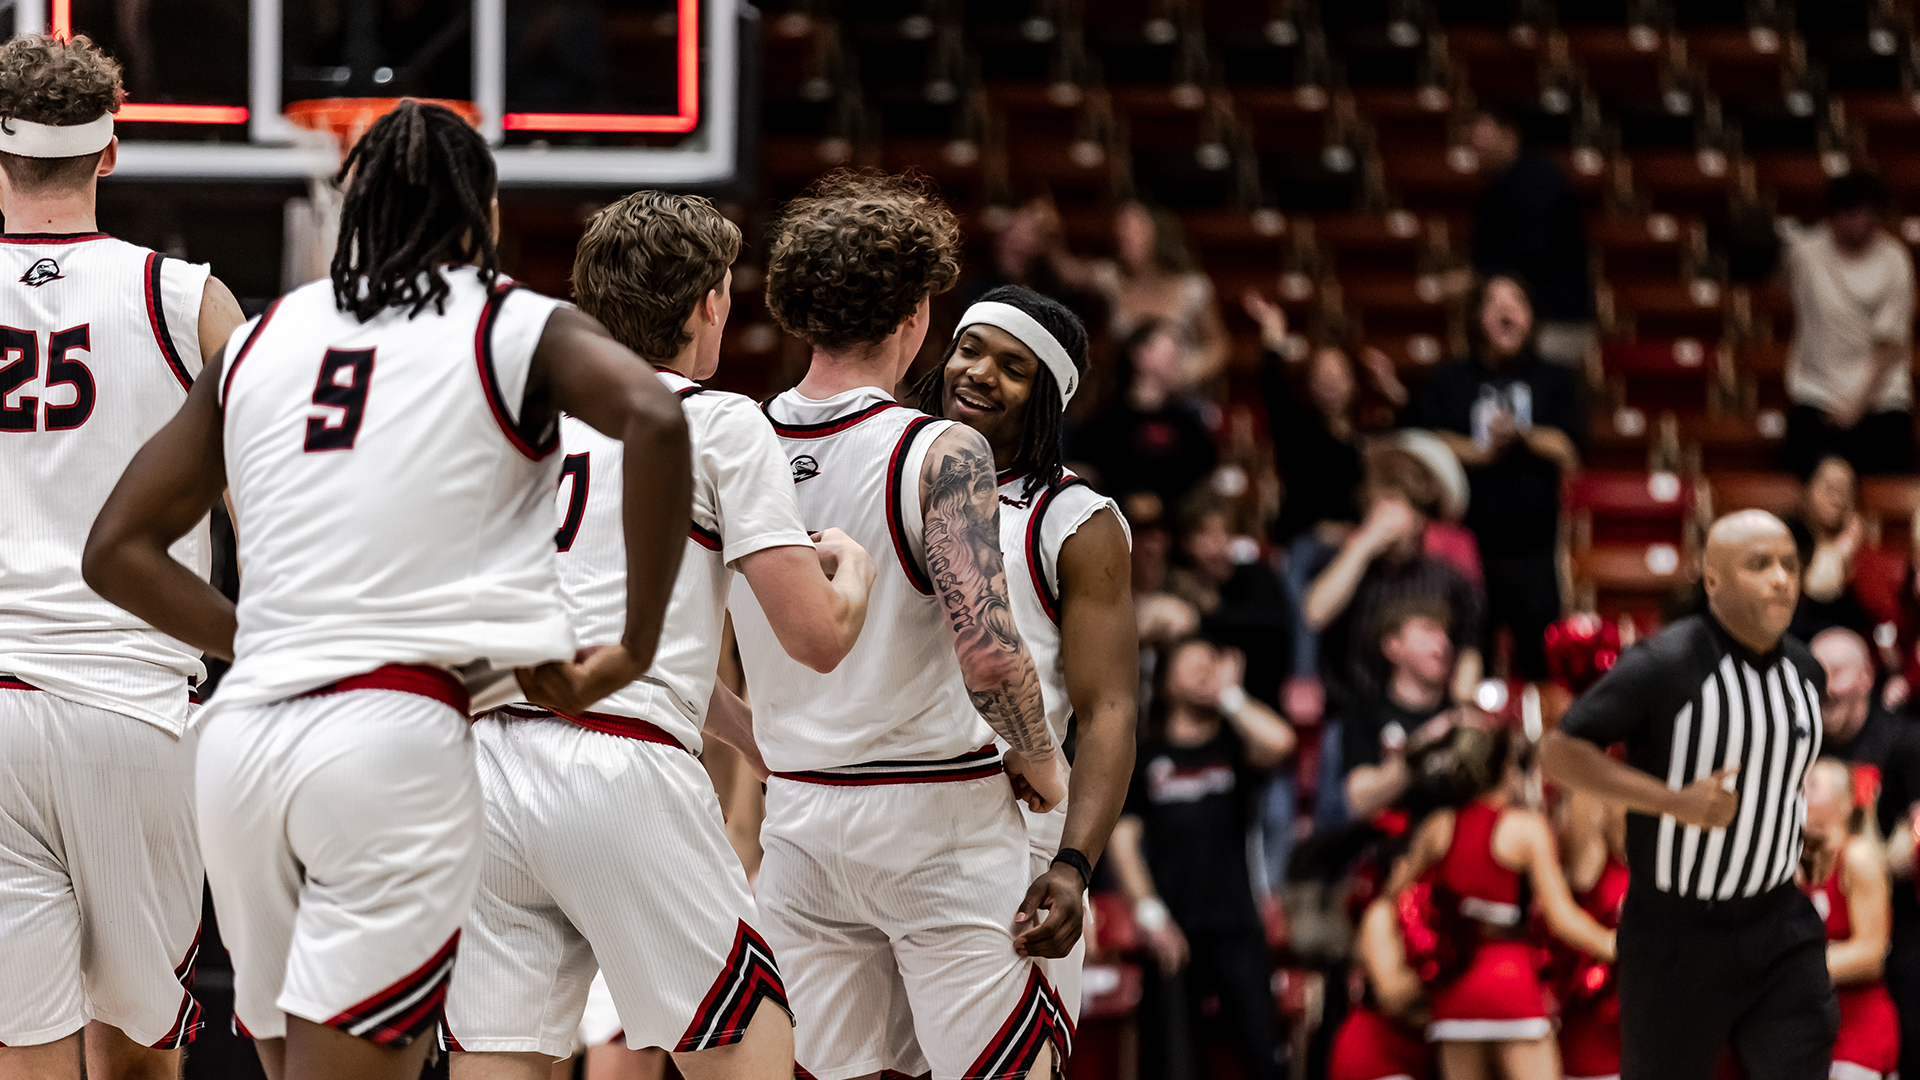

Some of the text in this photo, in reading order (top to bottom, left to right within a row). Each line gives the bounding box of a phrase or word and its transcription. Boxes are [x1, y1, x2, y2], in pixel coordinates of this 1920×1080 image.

[0, 322, 96, 432] 25
[303, 347, 376, 453] 9
[924, 518, 975, 633] Chosen
